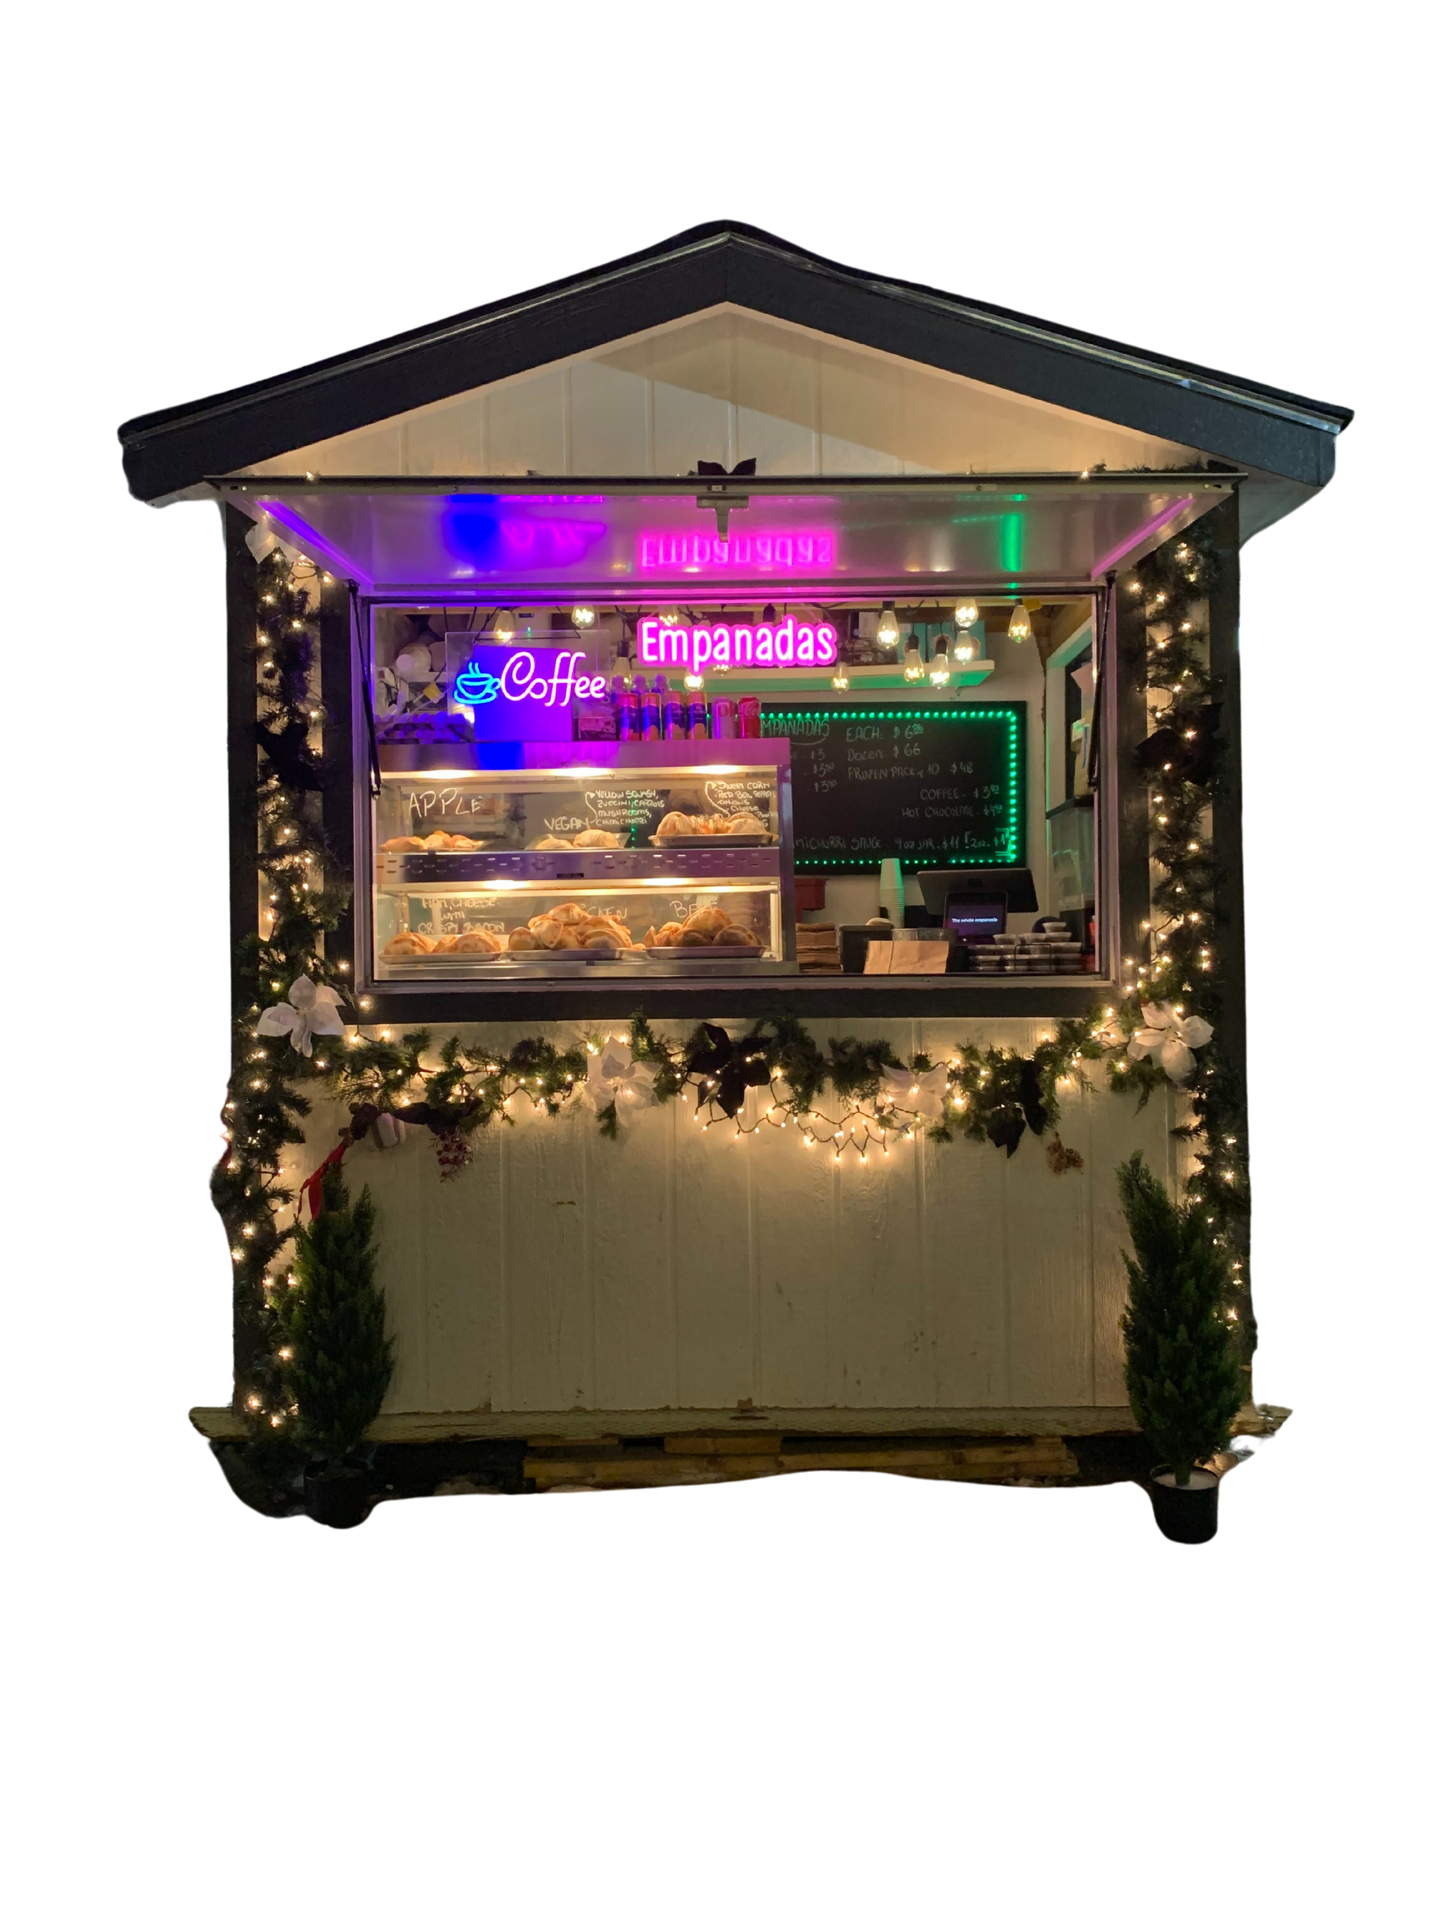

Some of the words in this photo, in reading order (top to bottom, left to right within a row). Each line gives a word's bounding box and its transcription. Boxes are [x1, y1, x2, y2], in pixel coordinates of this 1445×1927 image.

[641, 618, 833, 673] Empanadas
[500, 651, 606, 707] Coffee
[760, 719, 830, 737] MPANADAS
[847, 766, 888, 781] FROZEN
[891, 766, 915, 778] PACK
[747, 782, 770, 790] CORN
[596, 790, 624, 799] YELLOW
[919, 788, 961, 801] COFFEE
[408, 788, 484, 818] APPLE
[924, 805, 974, 818] CHOCOLATE
[543, 816, 591, 831] VEGAN
